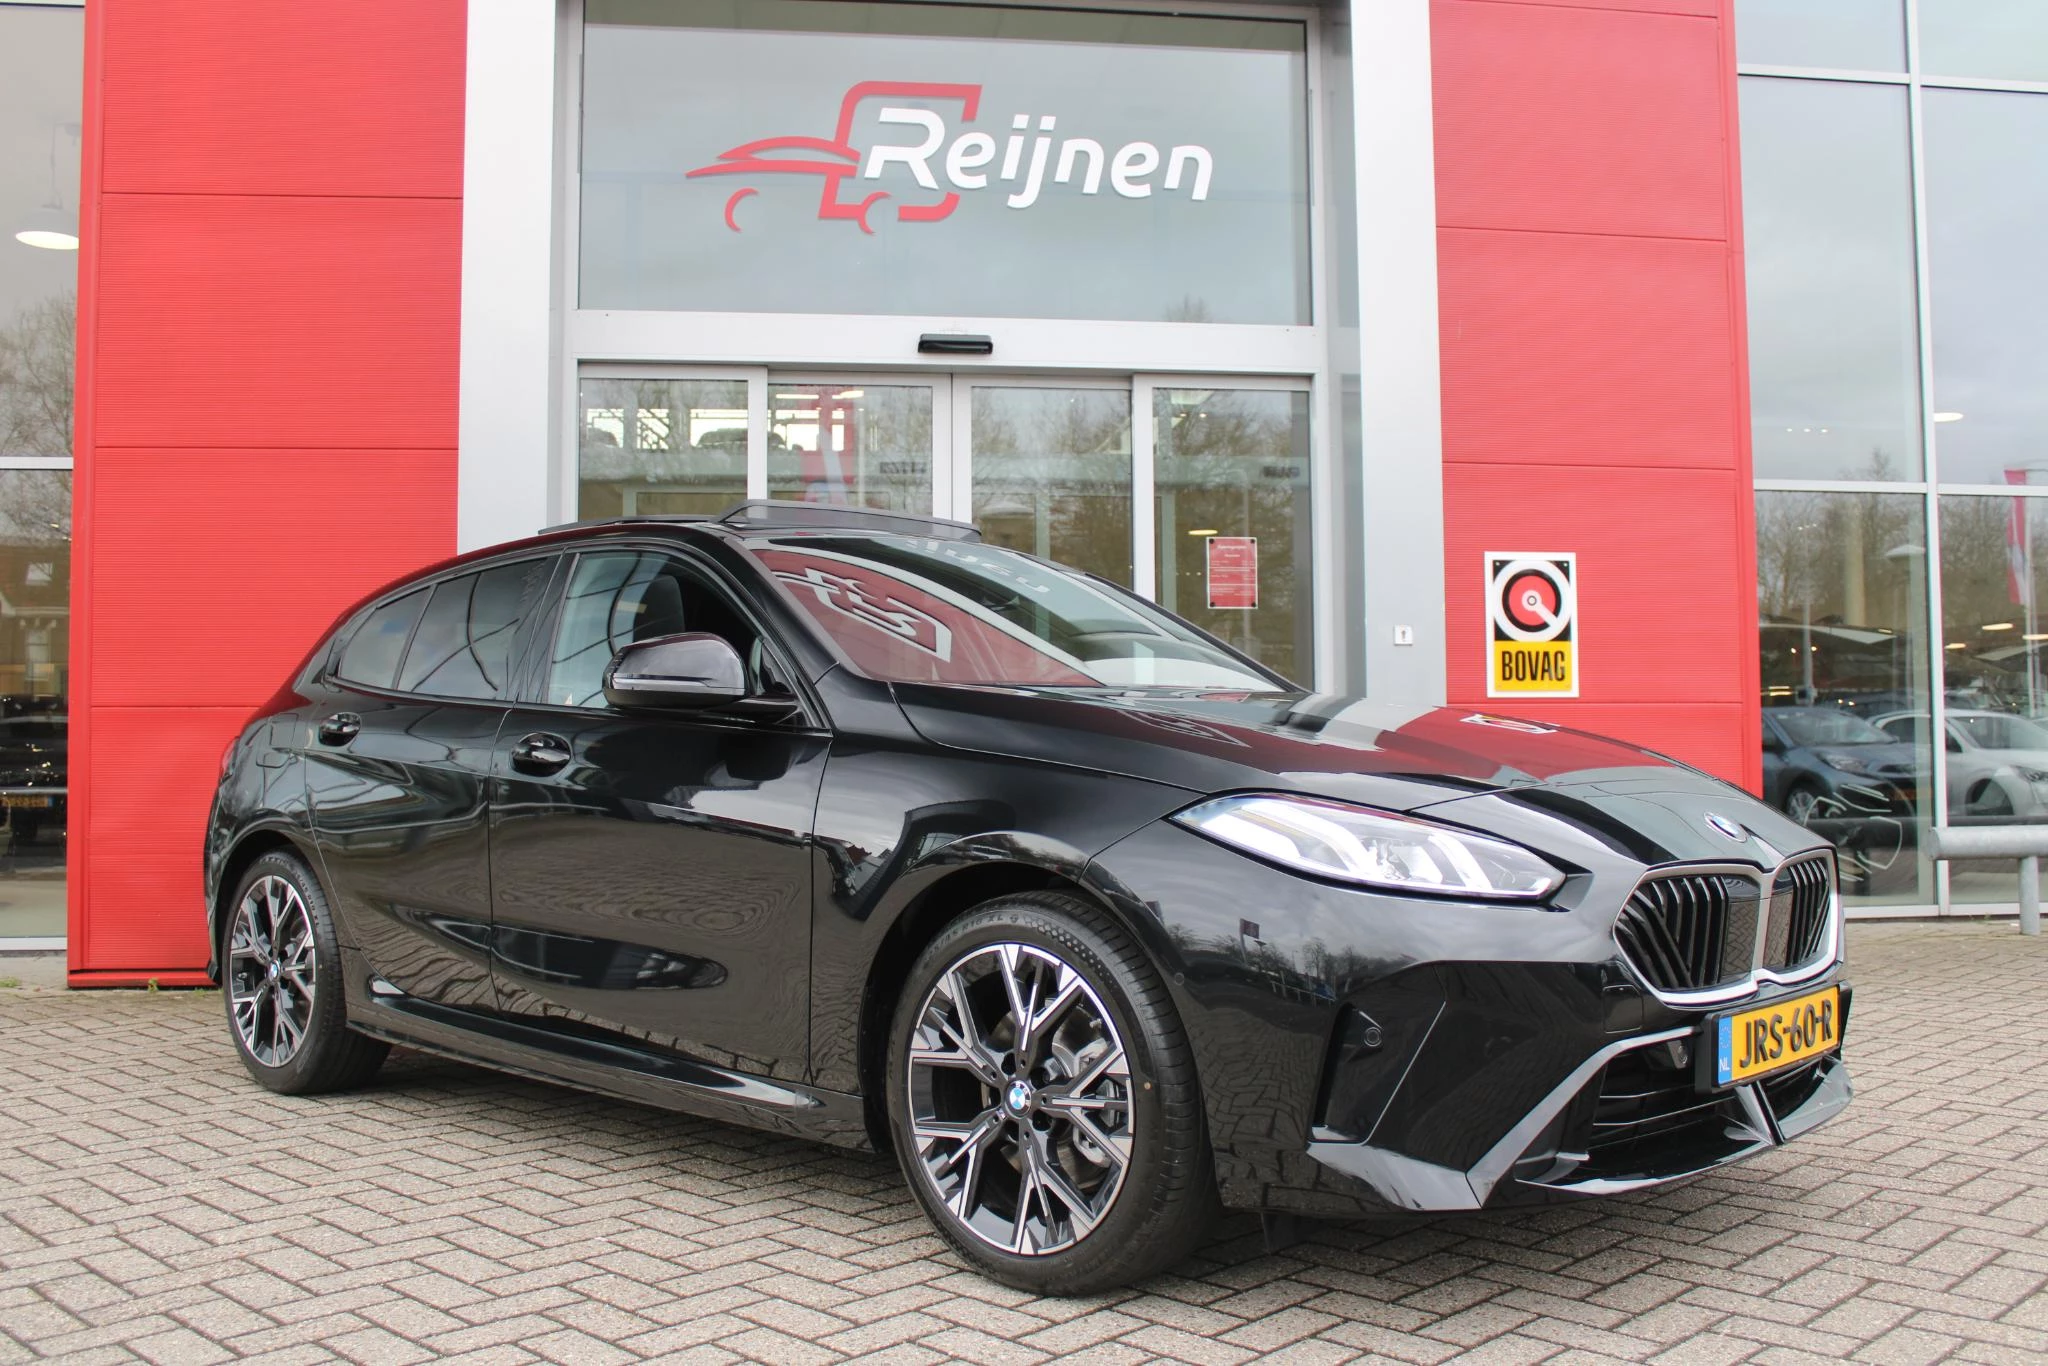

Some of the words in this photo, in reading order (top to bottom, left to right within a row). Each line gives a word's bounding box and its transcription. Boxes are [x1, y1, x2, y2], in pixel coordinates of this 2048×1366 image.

[864, 107, 1213, 209] Reijnen
[1502, 650, 1565, 682] BOVAG
[1740, 999, 1832, 1068] JRS-60-R
[1719, 1058, 1730, 1073] NL
